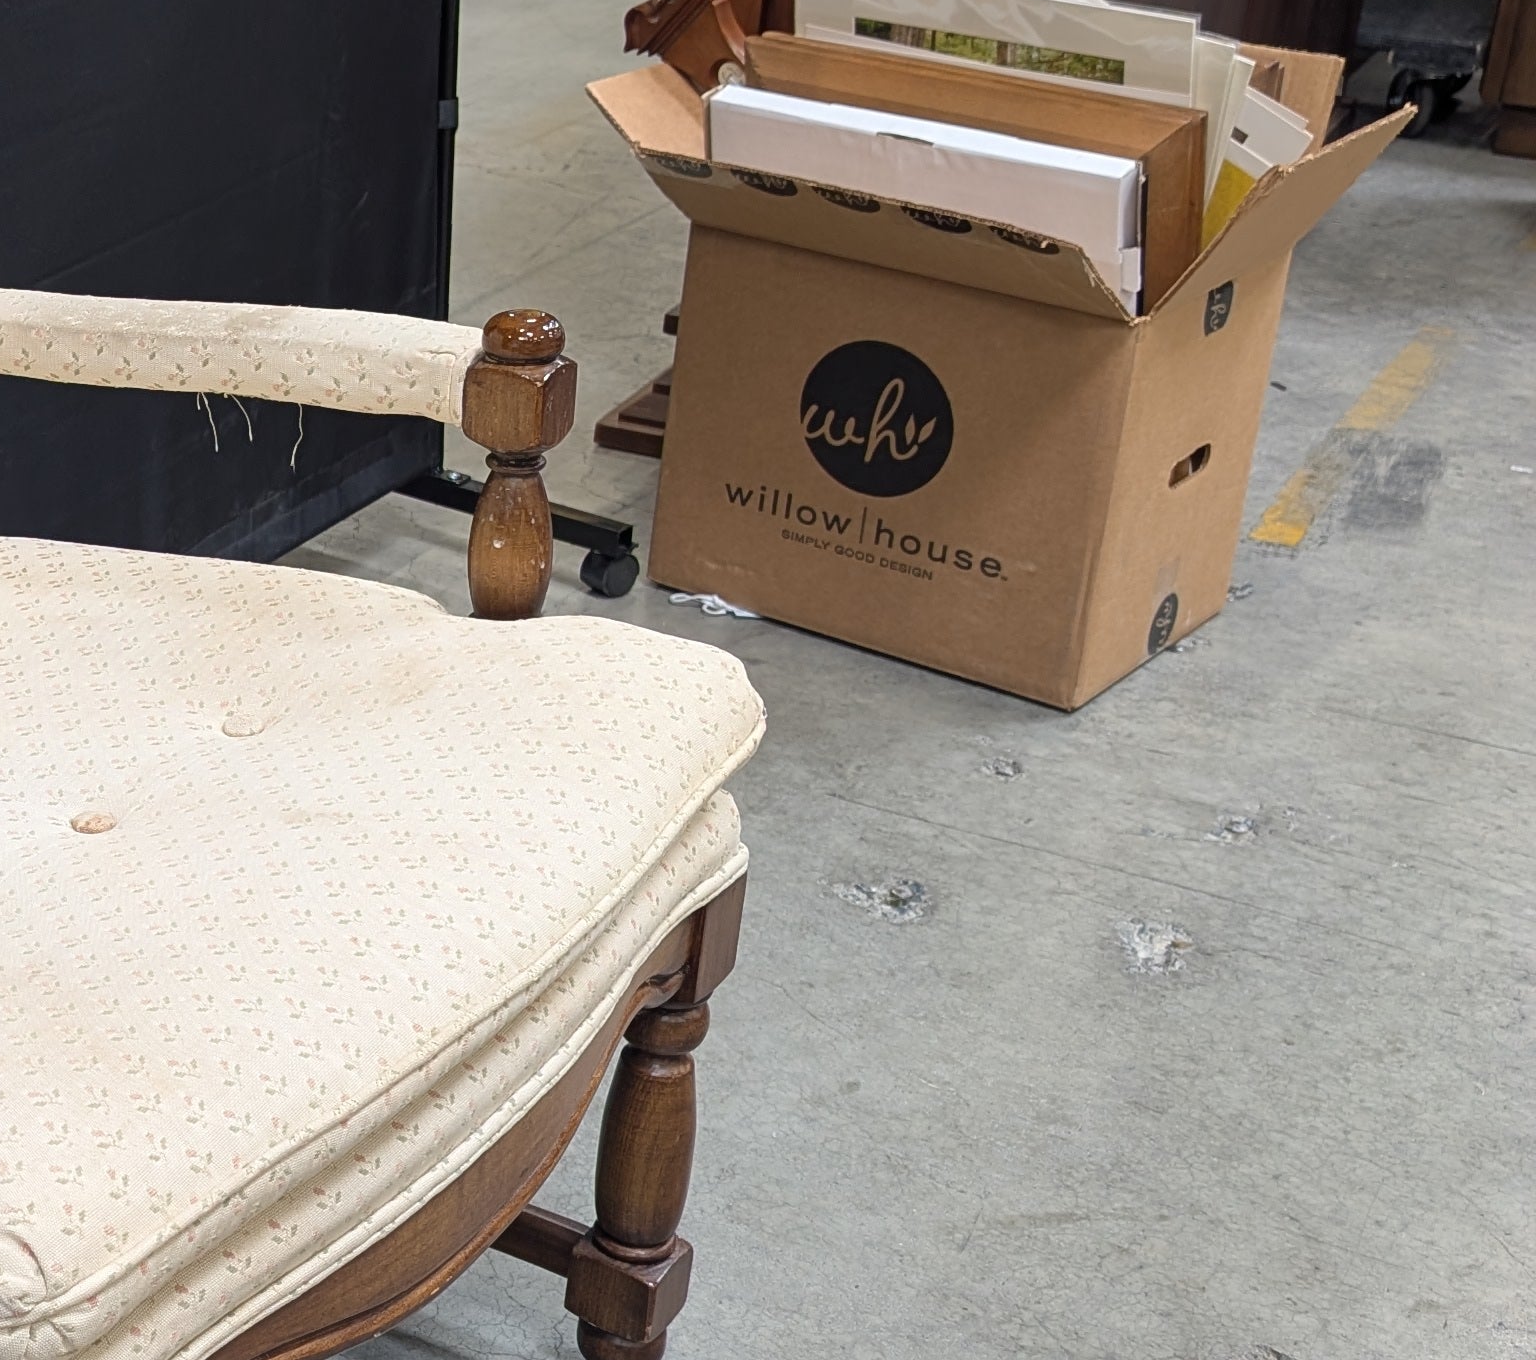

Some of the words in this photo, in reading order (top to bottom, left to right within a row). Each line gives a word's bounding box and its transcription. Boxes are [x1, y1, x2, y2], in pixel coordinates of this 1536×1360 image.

[781, 528, 830, 551] SIMPLY
[834, 544, 875, 564] GOOD
[879, 557, 934, 581] DESIGN
